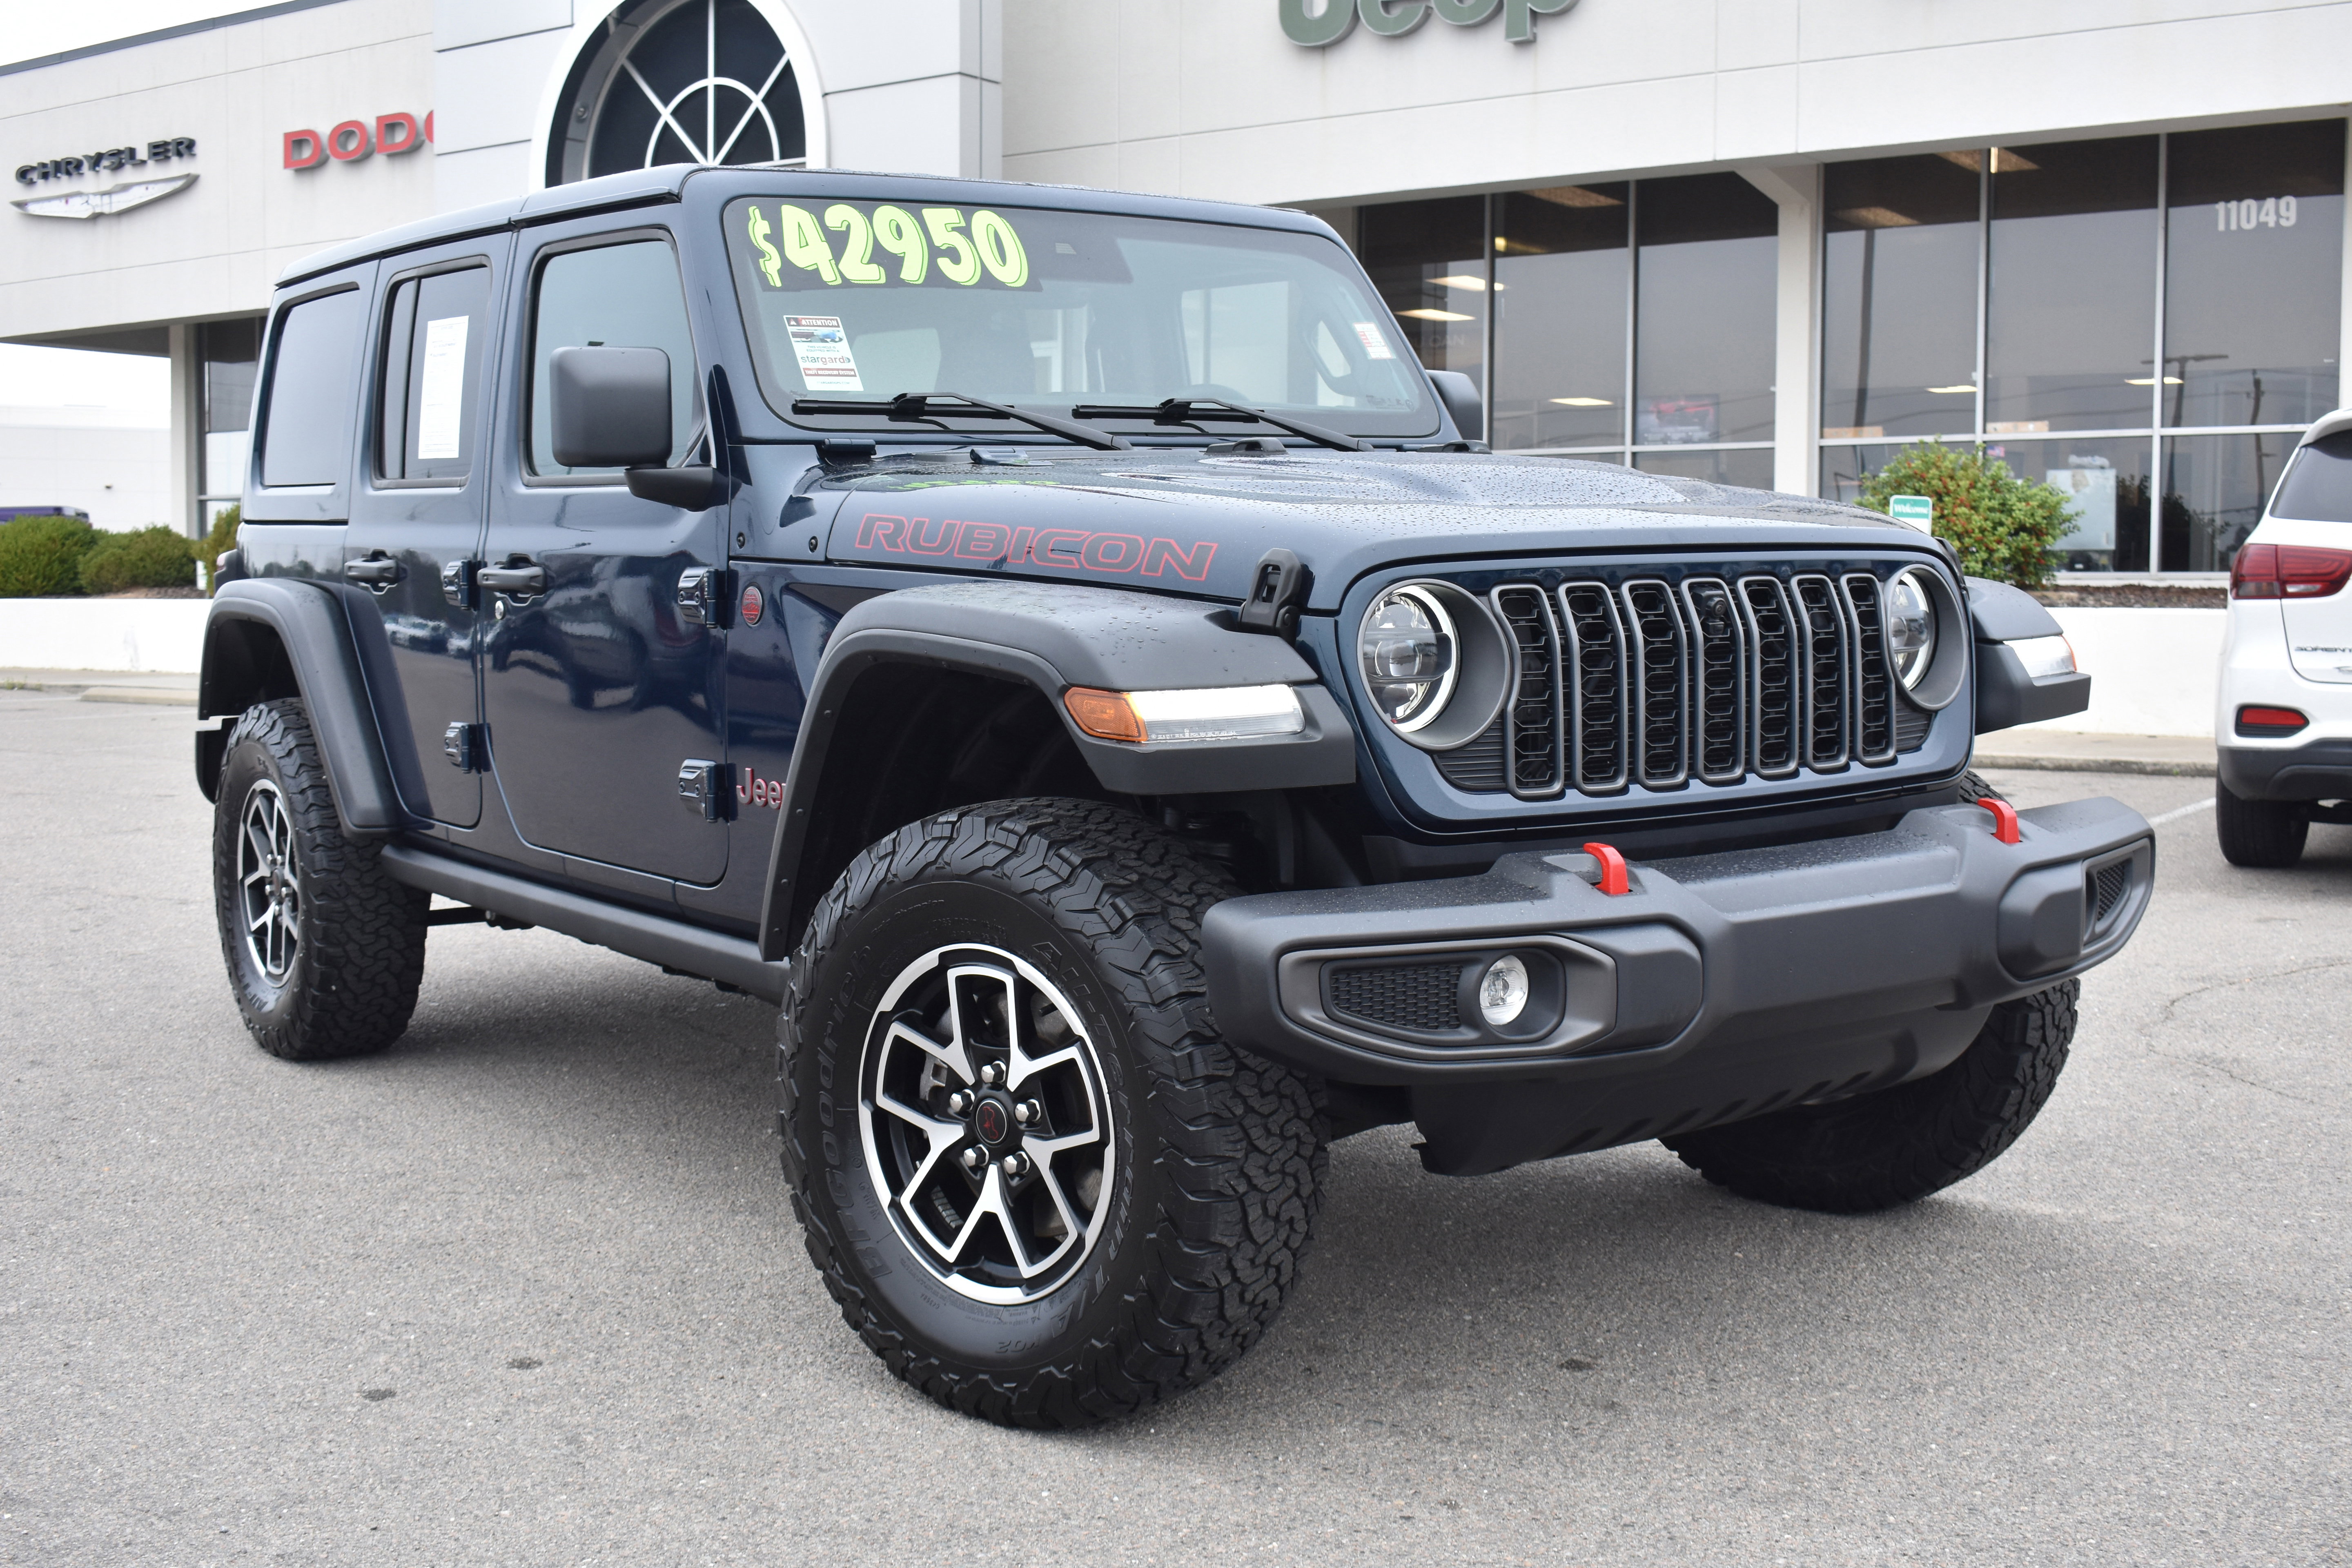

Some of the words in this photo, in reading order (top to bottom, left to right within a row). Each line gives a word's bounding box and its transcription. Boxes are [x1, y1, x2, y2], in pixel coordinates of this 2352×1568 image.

[15, 136, 196, 185] CHRYSLER
[283, 110, 434, 170] DOD
[2216, 196, 2297, 232] 11049
[748, 204, 1028, 287] $42950
[801, 355, 845, 365] stargard
[1894, 503, 1929, 514] Welcome
[855, 513, 1218, 581] RUBICON
[736, 767, 786, 810] Jee
[817, 944, 893, 1282] BFGoodrich
